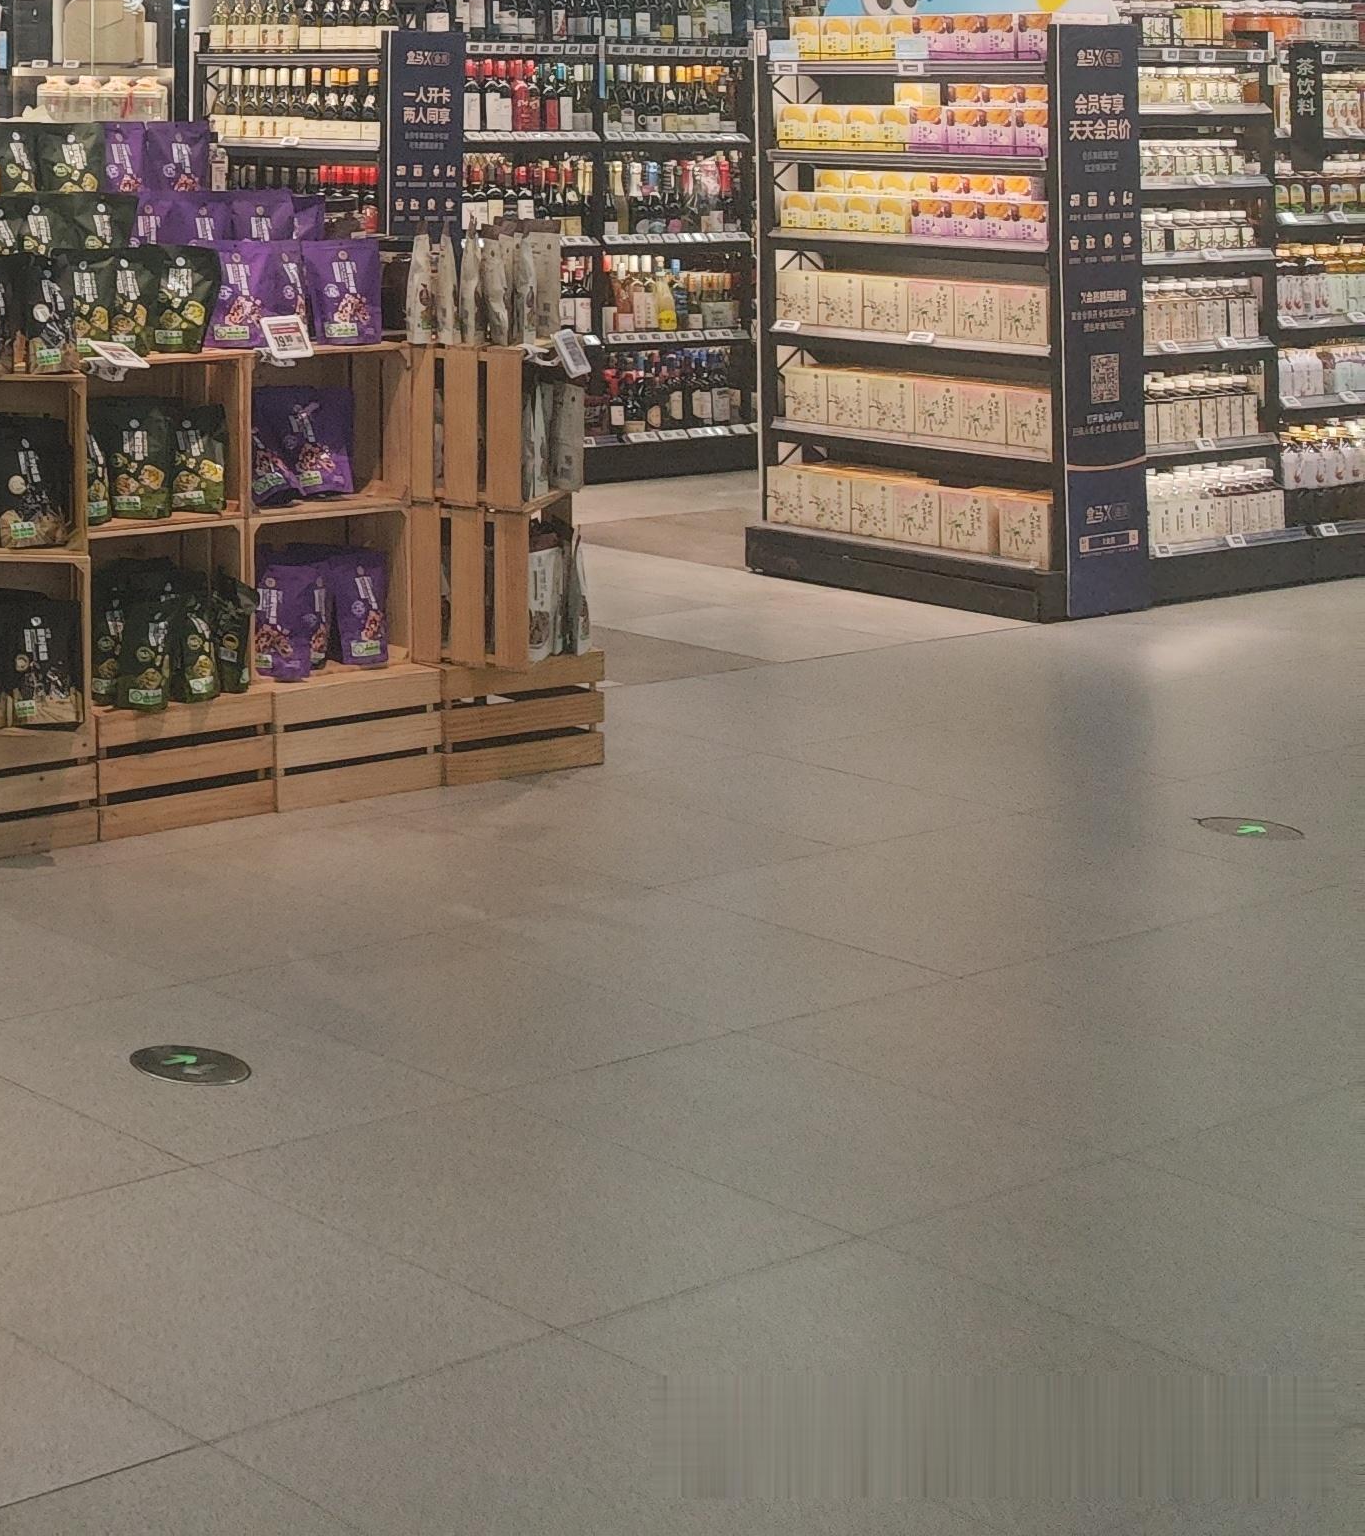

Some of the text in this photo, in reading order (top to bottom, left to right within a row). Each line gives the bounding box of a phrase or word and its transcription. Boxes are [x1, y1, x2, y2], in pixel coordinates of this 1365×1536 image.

[403, 86, 452, 104] 一人开卡
[1295, 57, 1317, 117] 茶饮料
[1074, 93, 1125, 115] 会员专享
[403, 106, 452, 125] 两人同享
[1068, 118, 1132, 141] 天天会员价
